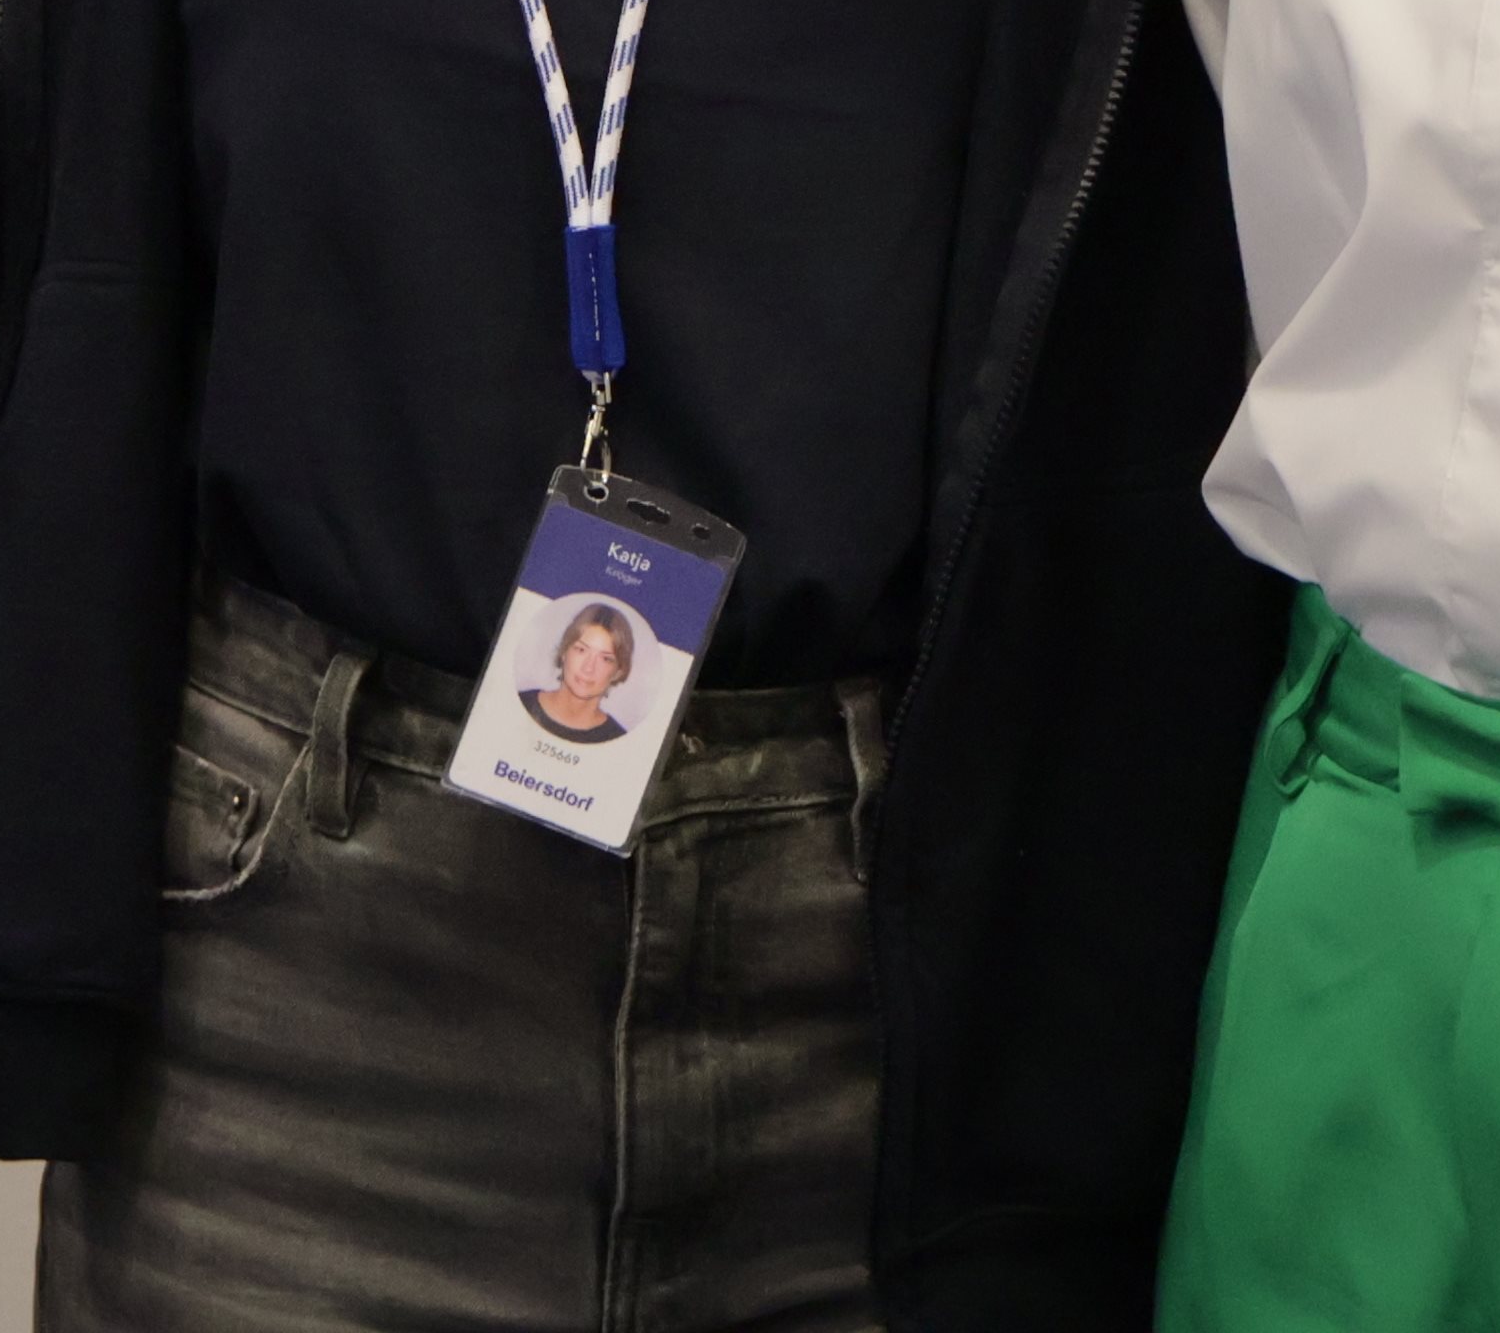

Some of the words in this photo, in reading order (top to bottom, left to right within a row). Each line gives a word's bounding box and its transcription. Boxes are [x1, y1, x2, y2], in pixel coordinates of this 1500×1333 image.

[607, 542, 651, 572] Katja
[534, 740, 580, 765] 325669
[494, 760, 594, 811] Beiersdorf
